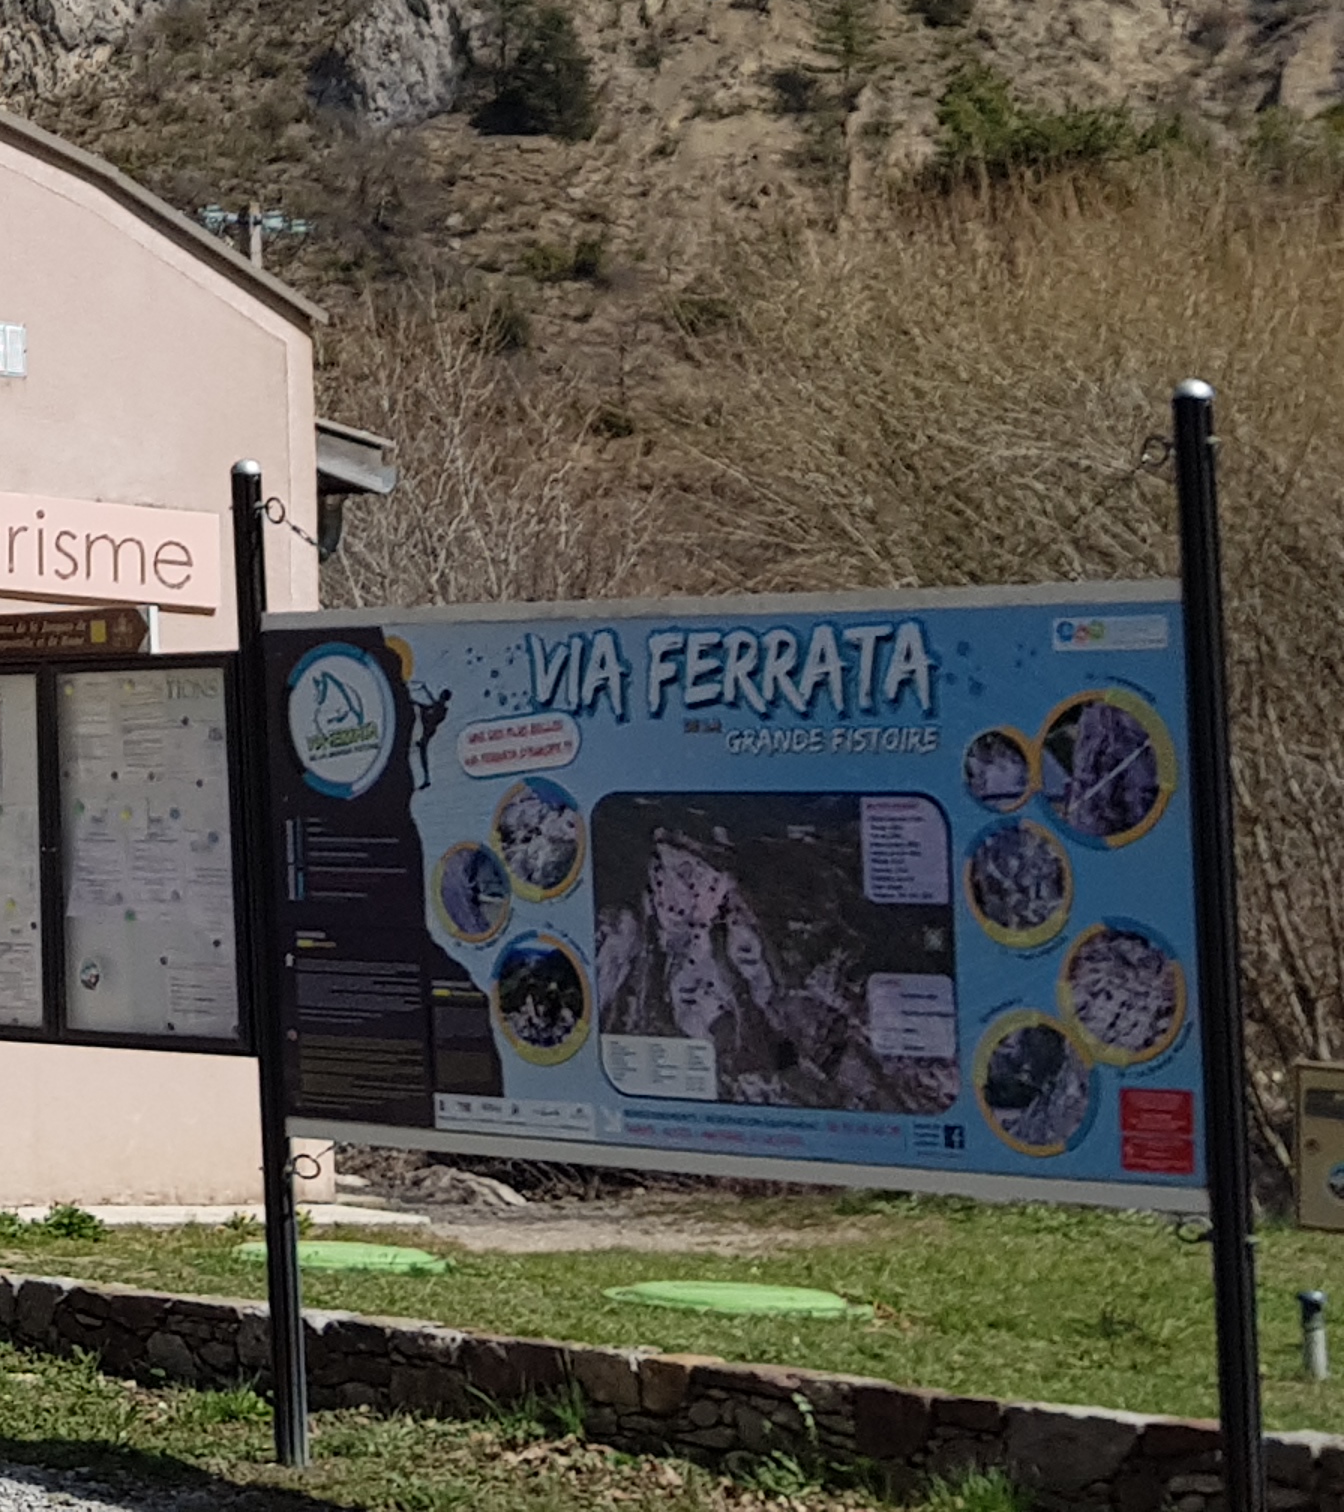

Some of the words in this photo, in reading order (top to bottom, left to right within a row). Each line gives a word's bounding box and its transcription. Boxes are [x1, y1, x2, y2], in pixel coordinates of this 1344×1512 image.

[529, 628, 629, 723] VIA
[648, 620, 940, 720] FERRATA
[166, 678, 218, 700] TIONS
[724, 728, 826, 756] GRANDE
[830, 726, 940, 754] FISTOIRE
